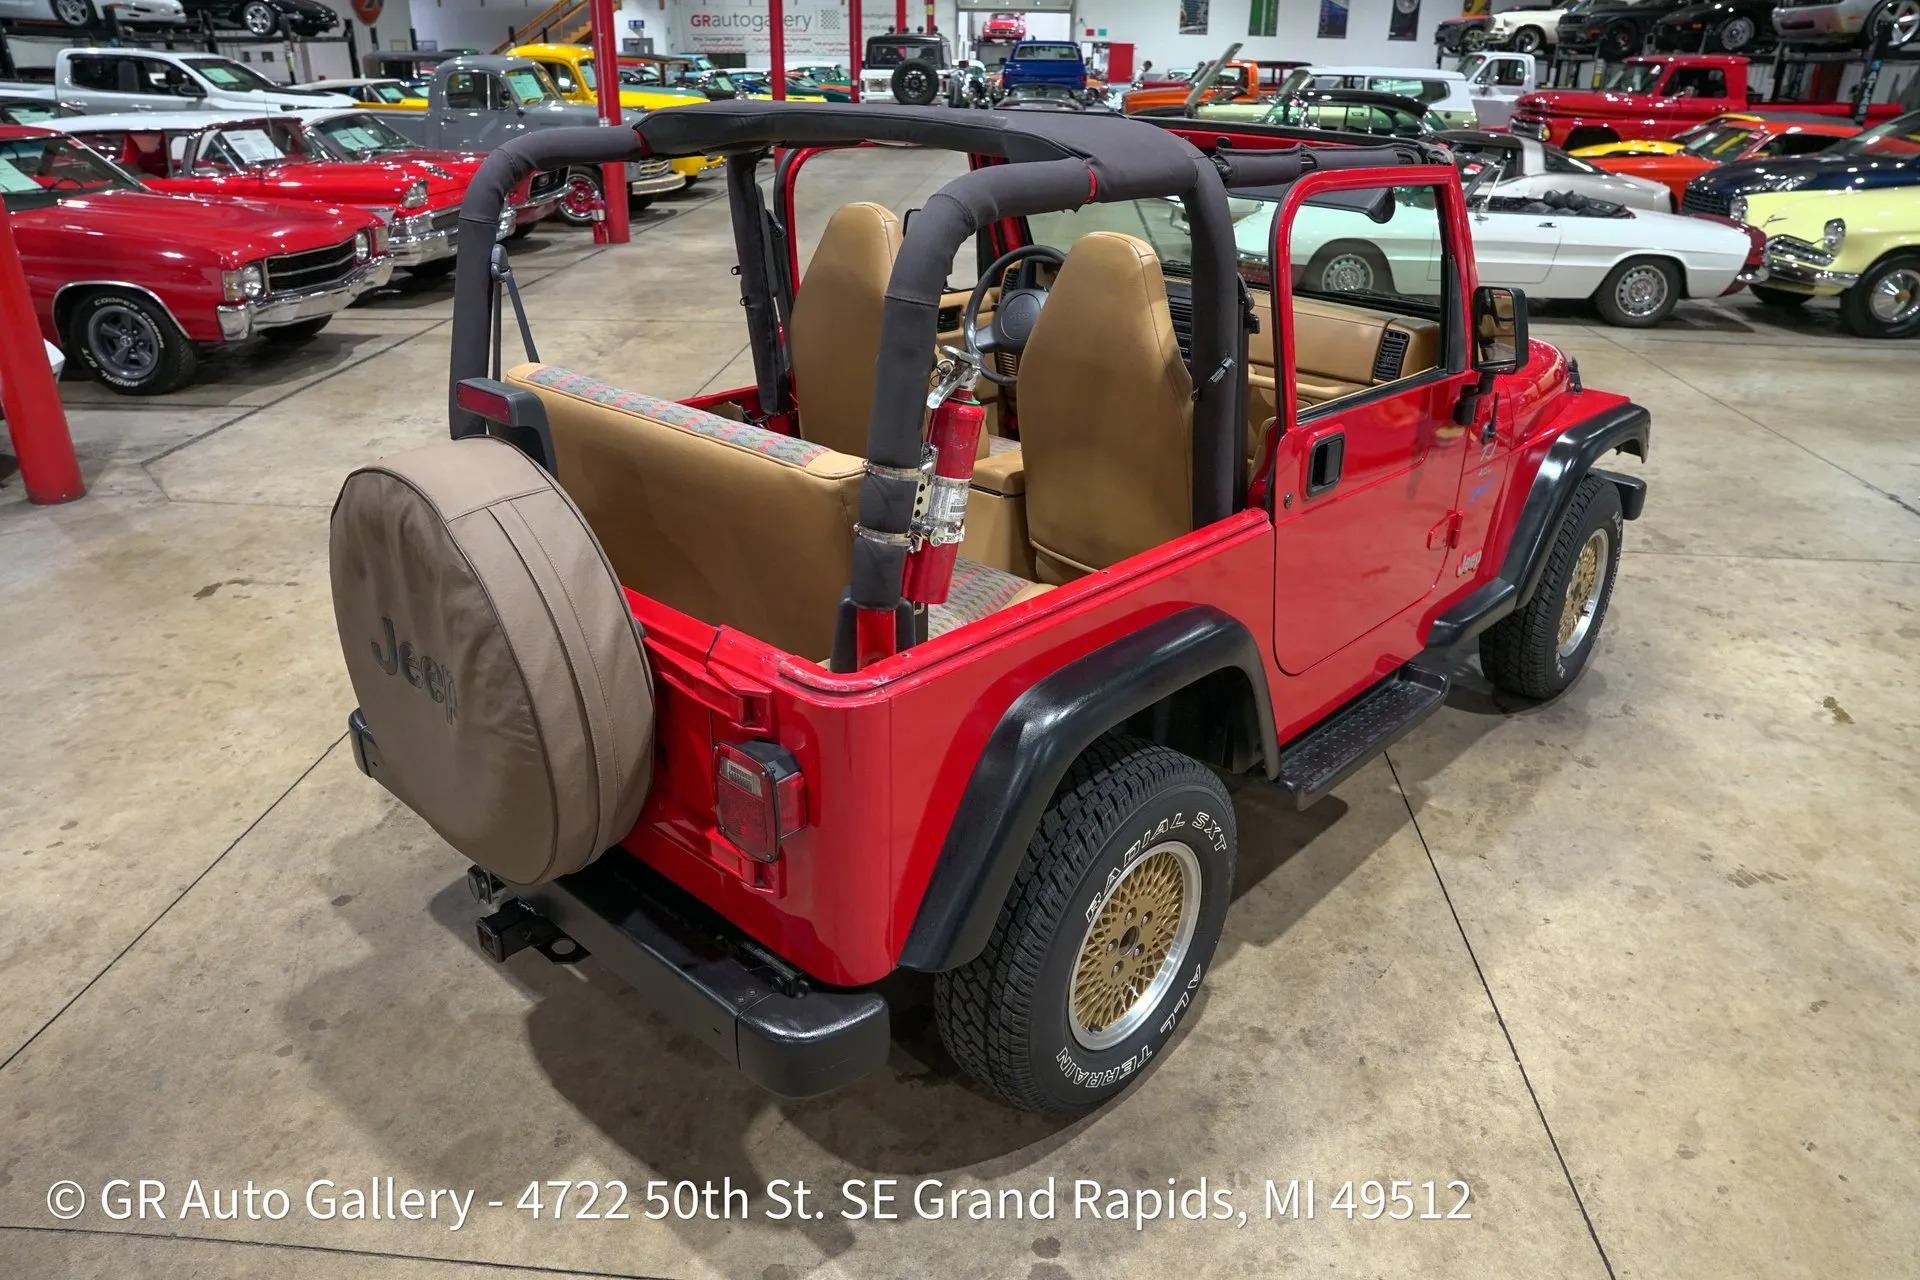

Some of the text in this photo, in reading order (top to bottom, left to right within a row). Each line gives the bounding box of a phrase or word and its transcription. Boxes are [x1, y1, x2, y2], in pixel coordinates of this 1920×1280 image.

[690, 12, 812, 33] GRautogaery
[93, 297, 139, 311] COOPER
[1457, 549, 1483, 577] Jeep
[369, 615, 460, 726] Jeep
[1085, 811, 1228, 923] RADIAL SXT
[1055, 962, 1201, 1089] ALL TERRAIN
